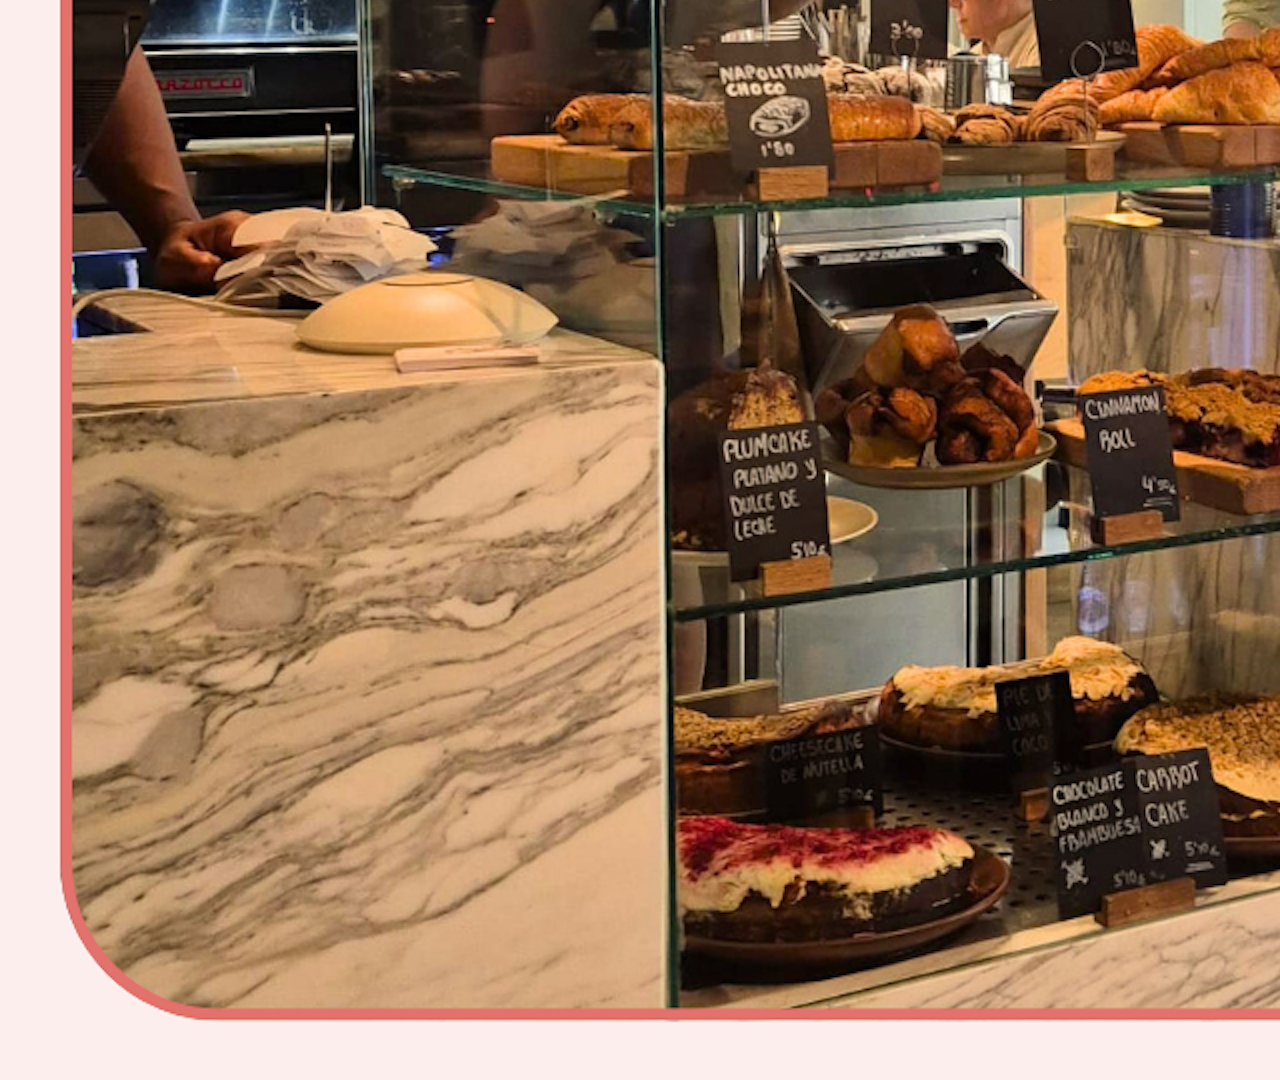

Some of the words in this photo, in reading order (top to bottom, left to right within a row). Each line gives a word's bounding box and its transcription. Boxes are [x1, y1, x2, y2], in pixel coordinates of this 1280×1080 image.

[725, 81, 787, 97] CHOCO
[1085, 391, 1160, 420] CINNAMON
[723, 429, 812, 463] PLUMCAKE
[1099, 427, 1137, 453] ROLL
[733, 461, 798, 489] PLATANO
[730, 491, 776, 518] DULCE
[780, 489, 800, 510] DE
[734, 515, 777, 542] LECHE
[1053, 771, 1124, 805] CHOCOLATE
[1136, 761, 1199, 793] CARROT
[1057, 803, 1108, 831] BLANCO
[1145, 800, 1189, 827] CAKE
[1059, 815, 1142, 853] FRAMBUESA
